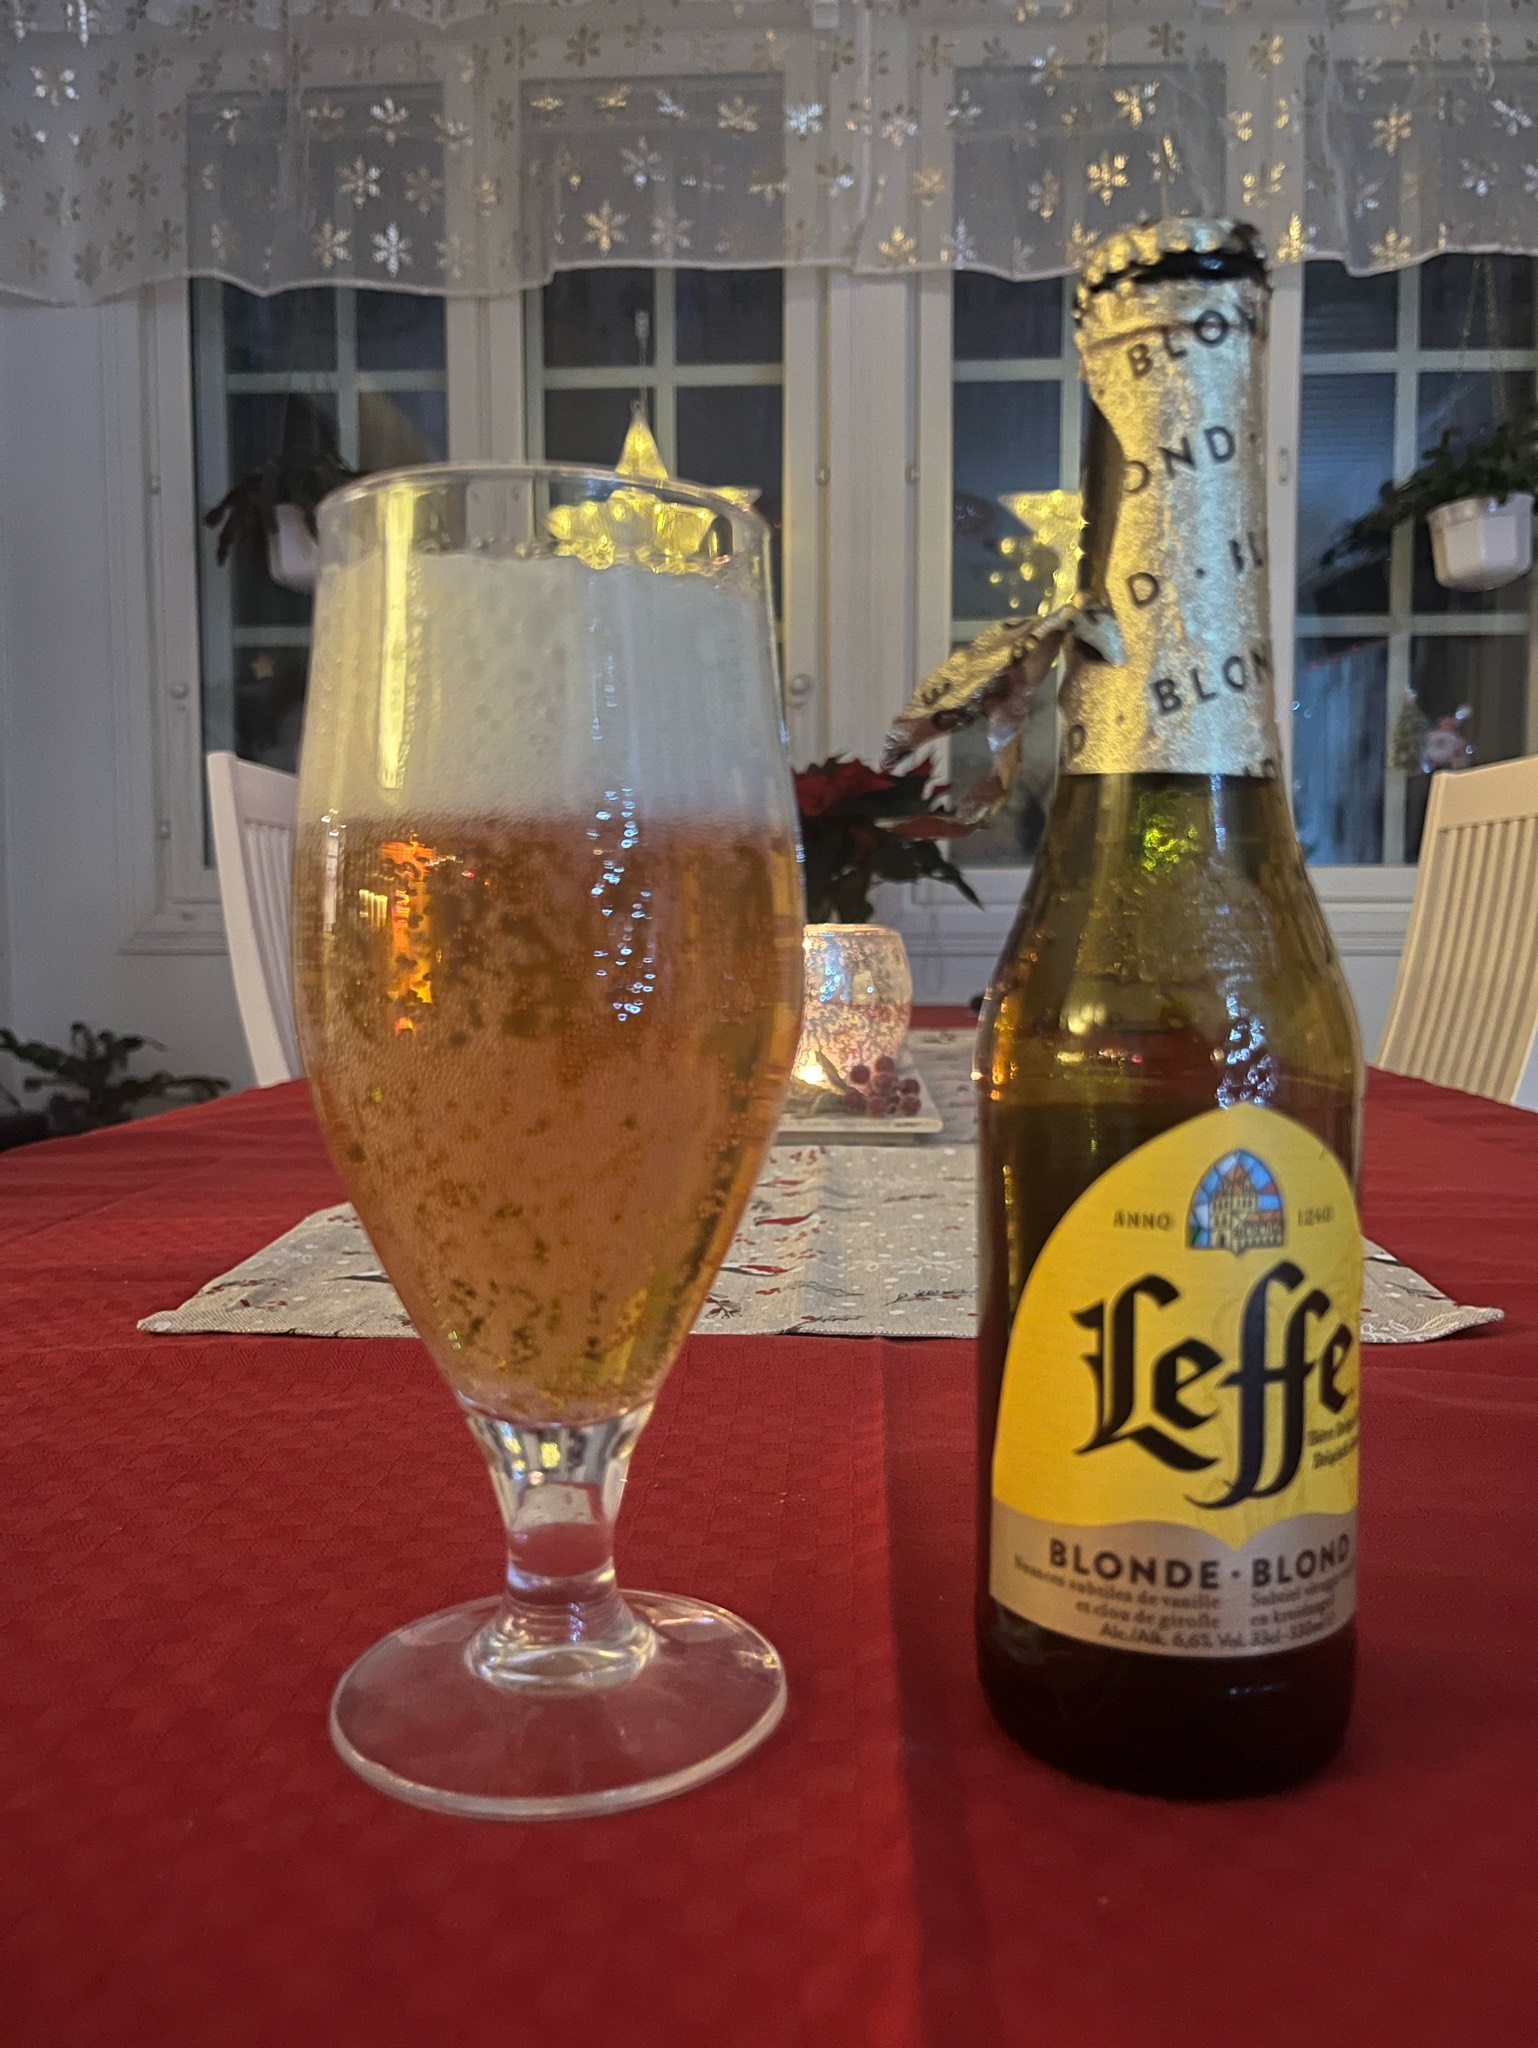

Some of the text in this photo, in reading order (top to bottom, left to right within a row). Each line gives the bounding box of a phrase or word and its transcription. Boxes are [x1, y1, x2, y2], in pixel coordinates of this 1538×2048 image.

[1112, 1209, 1173, 1231] ANNO
[1071, 1259, 1354, 1511] Leffe
[1050, 1537, 1221, 1590] BLONDE
[1252, 1532, 1350, 1588] BLOND
